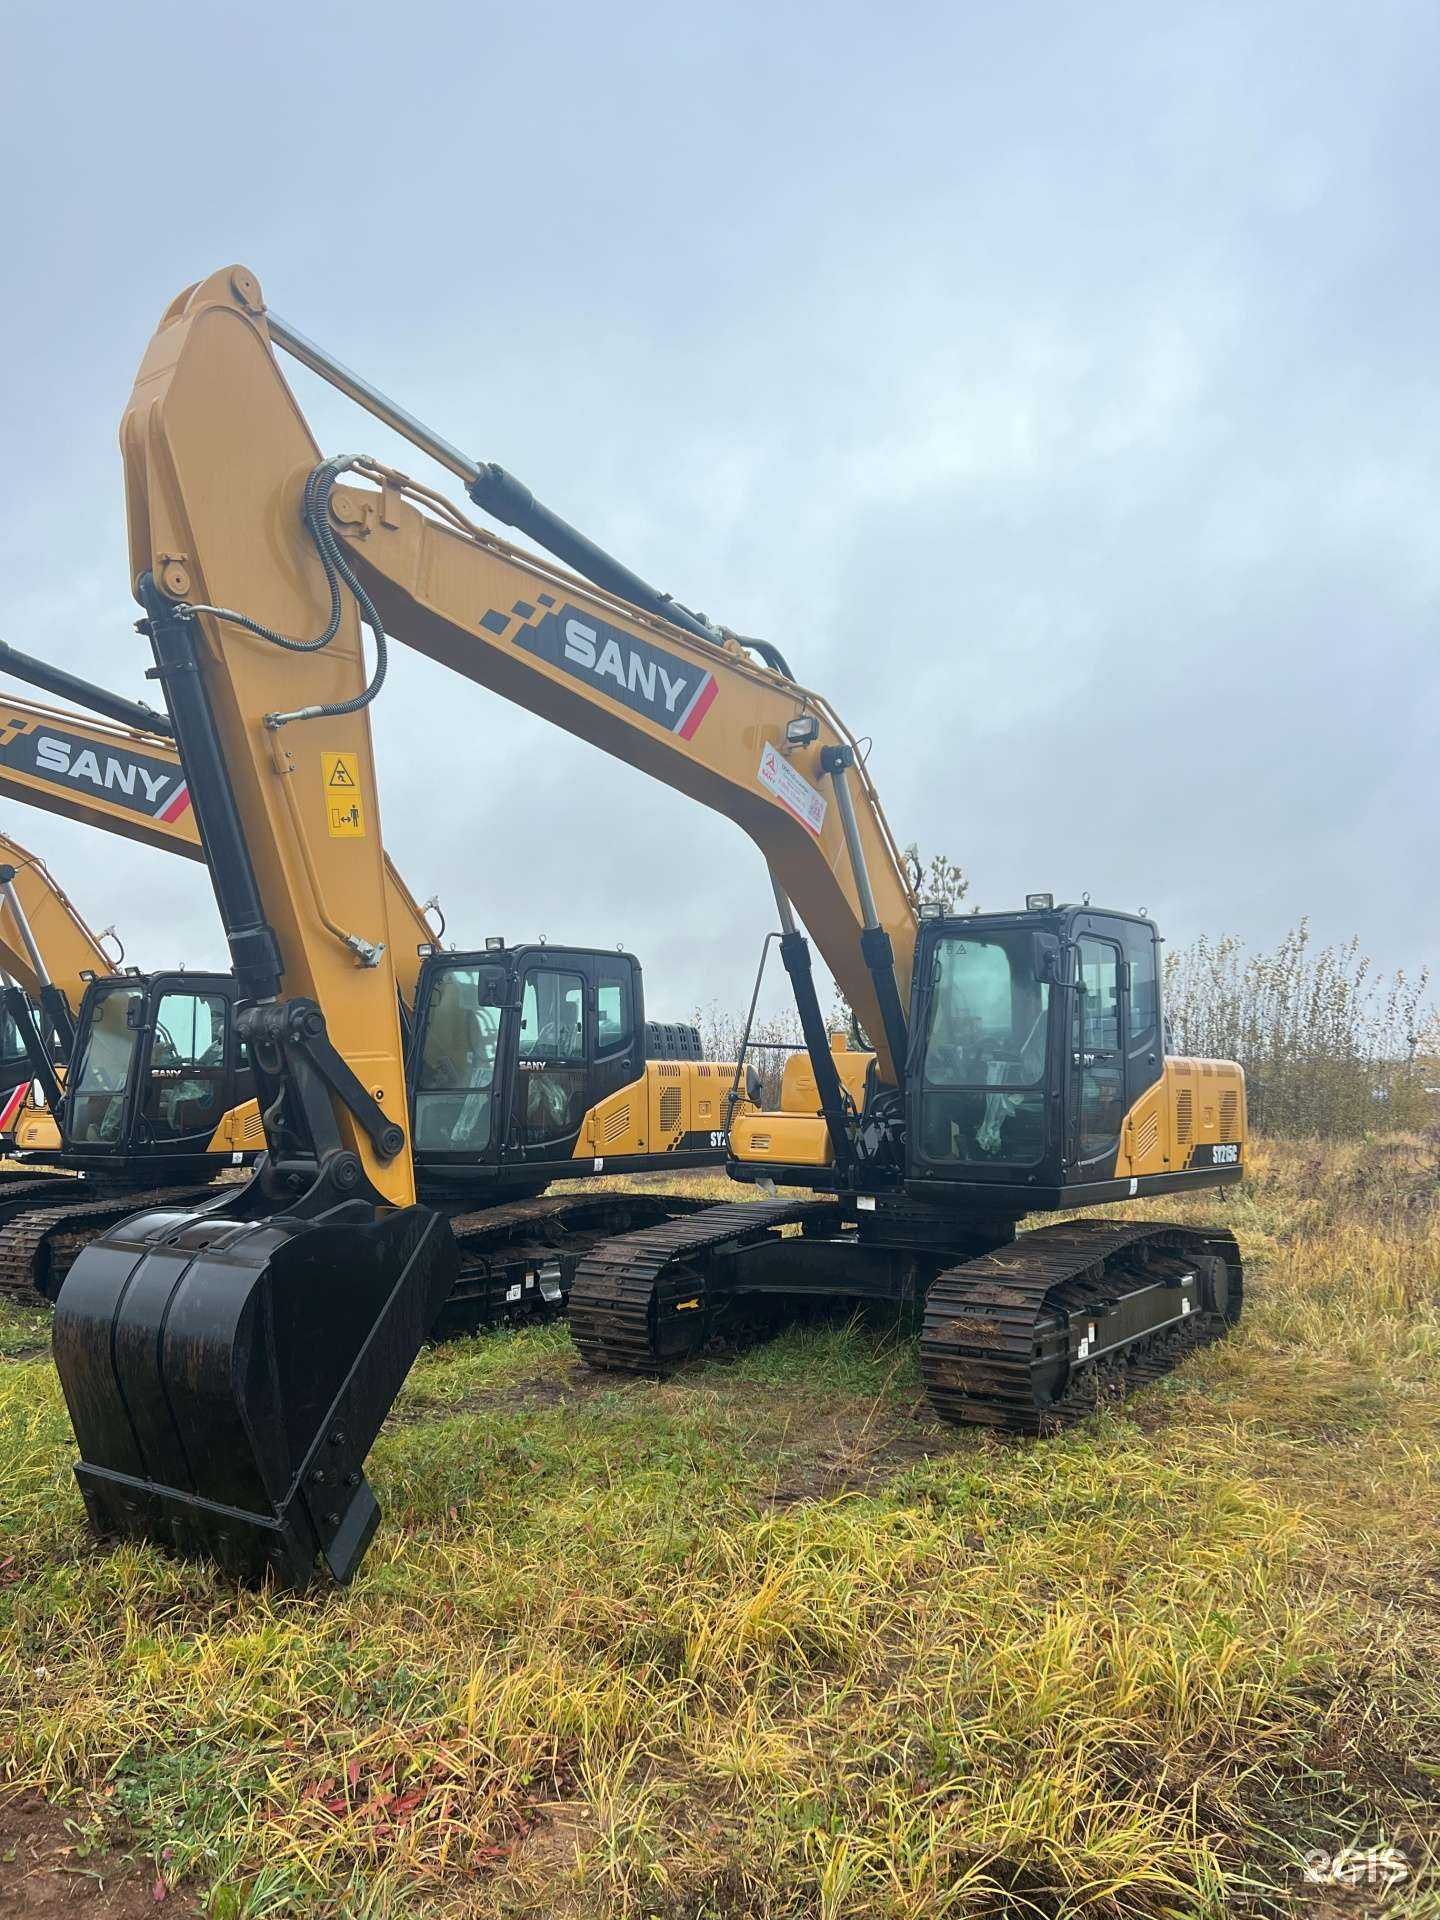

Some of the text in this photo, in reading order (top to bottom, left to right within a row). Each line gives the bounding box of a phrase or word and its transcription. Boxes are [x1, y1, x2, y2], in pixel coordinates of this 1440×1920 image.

[565, 619, 687, 712] SANY
[36, 736, 170, 802] SANY
[1073, 1053, 1095, 1064] SNY
[518, 1060, 546, 1071] SANY
[151, 1069, 182, 1079] SANY
